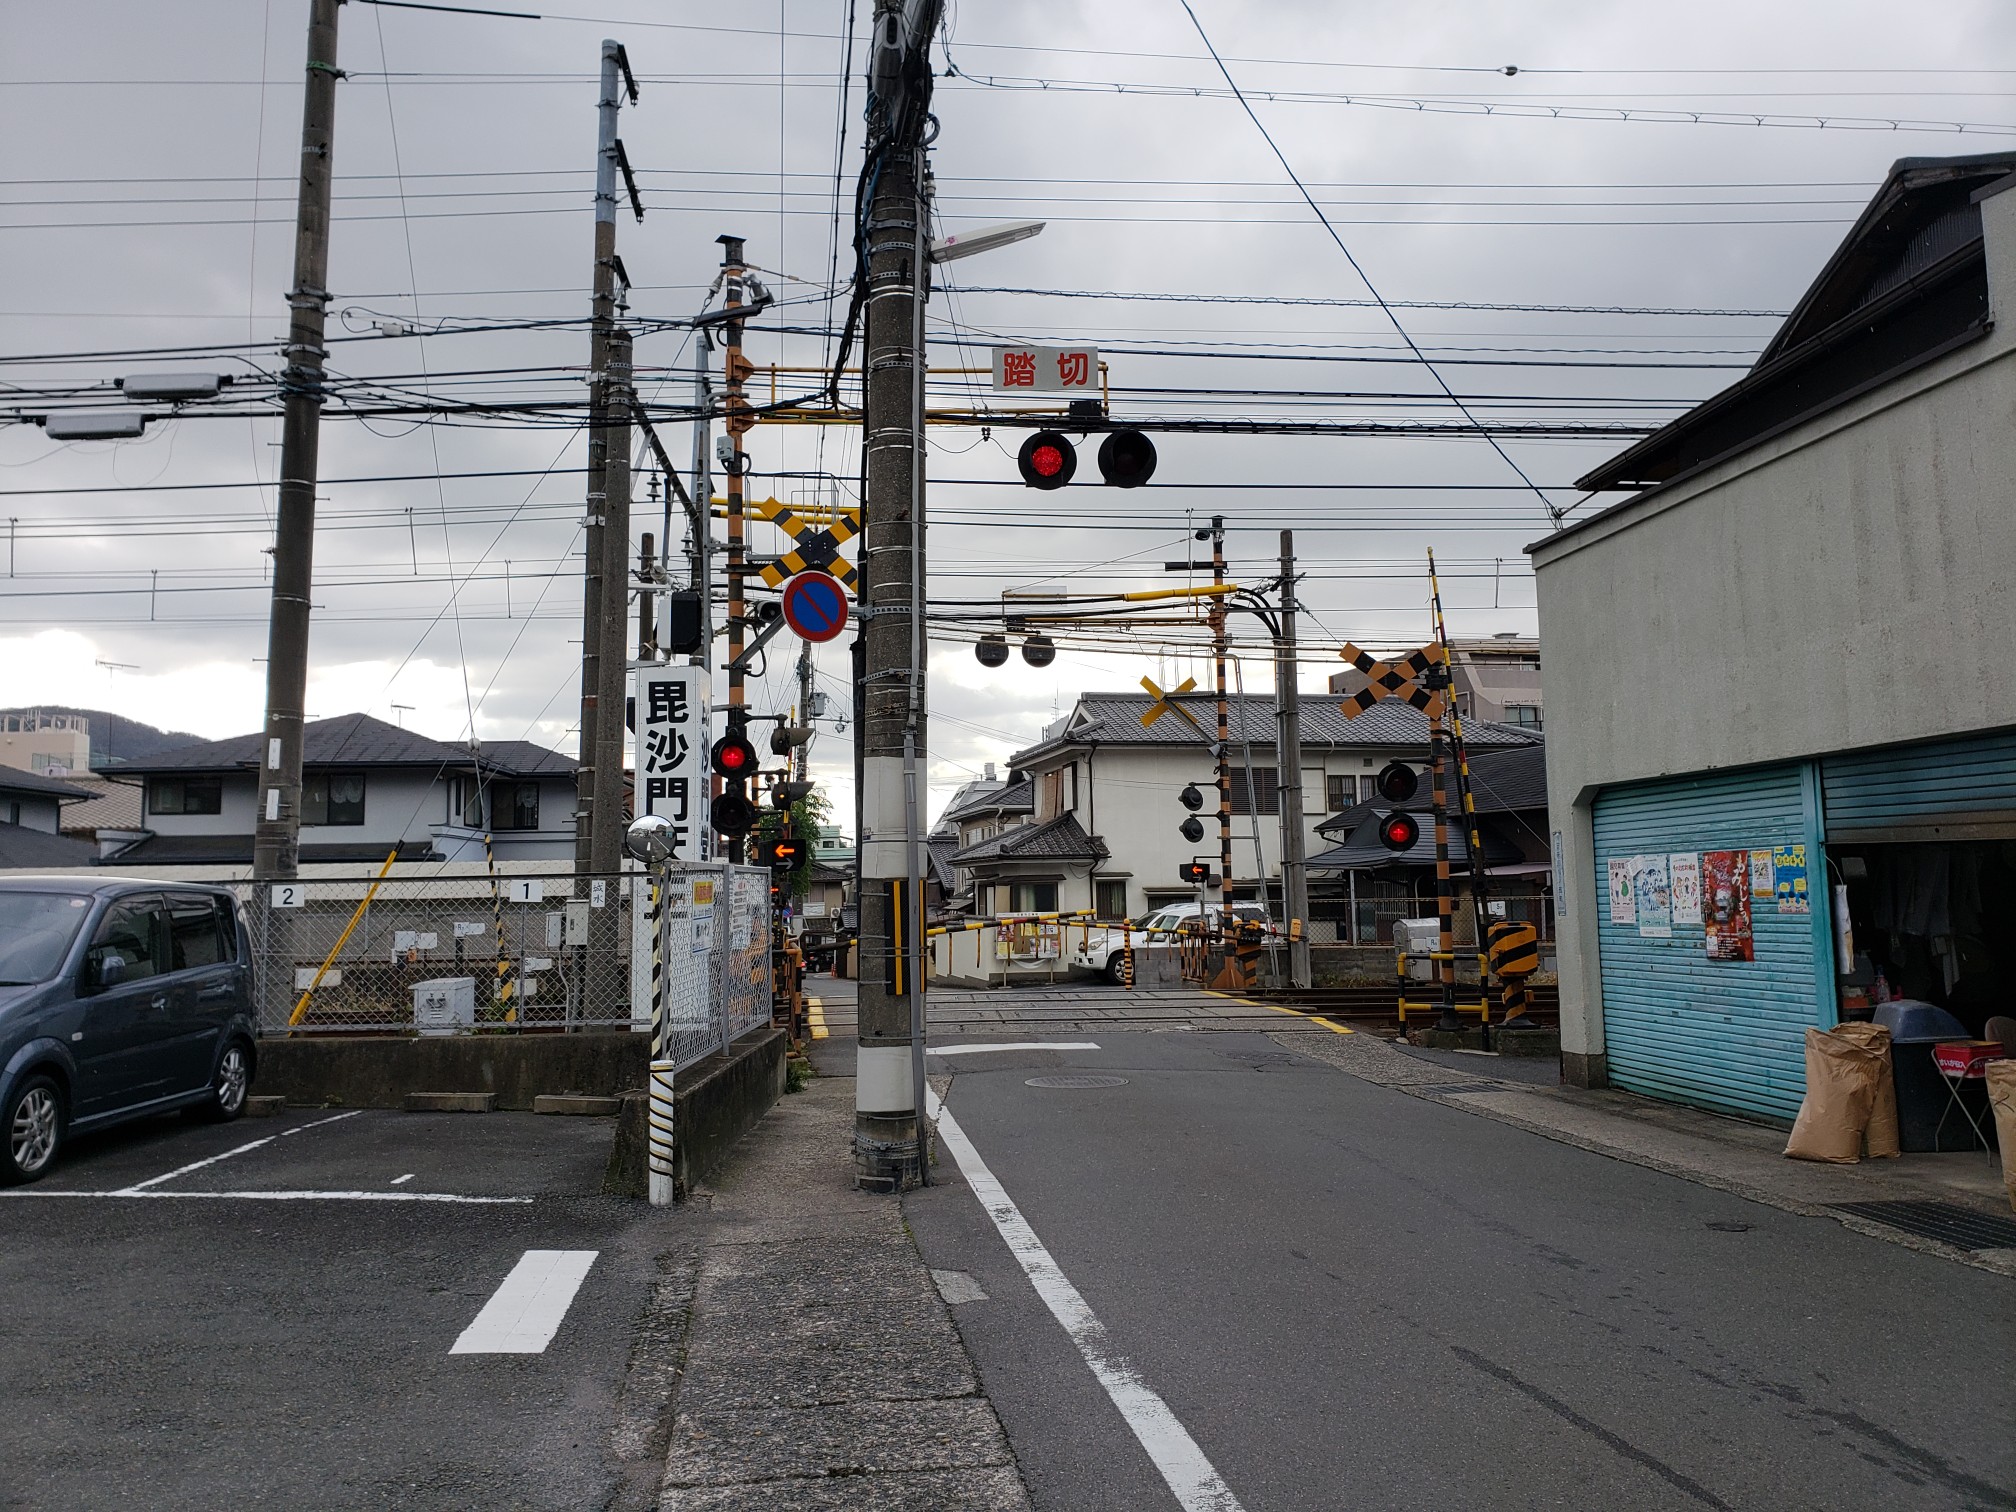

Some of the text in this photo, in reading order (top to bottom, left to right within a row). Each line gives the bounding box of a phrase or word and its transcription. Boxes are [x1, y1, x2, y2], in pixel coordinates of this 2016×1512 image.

[1003, 352, 1088, 386] 踏切
[283, 888, 293, 904] 2
[523, 883, 529, 899] 1
